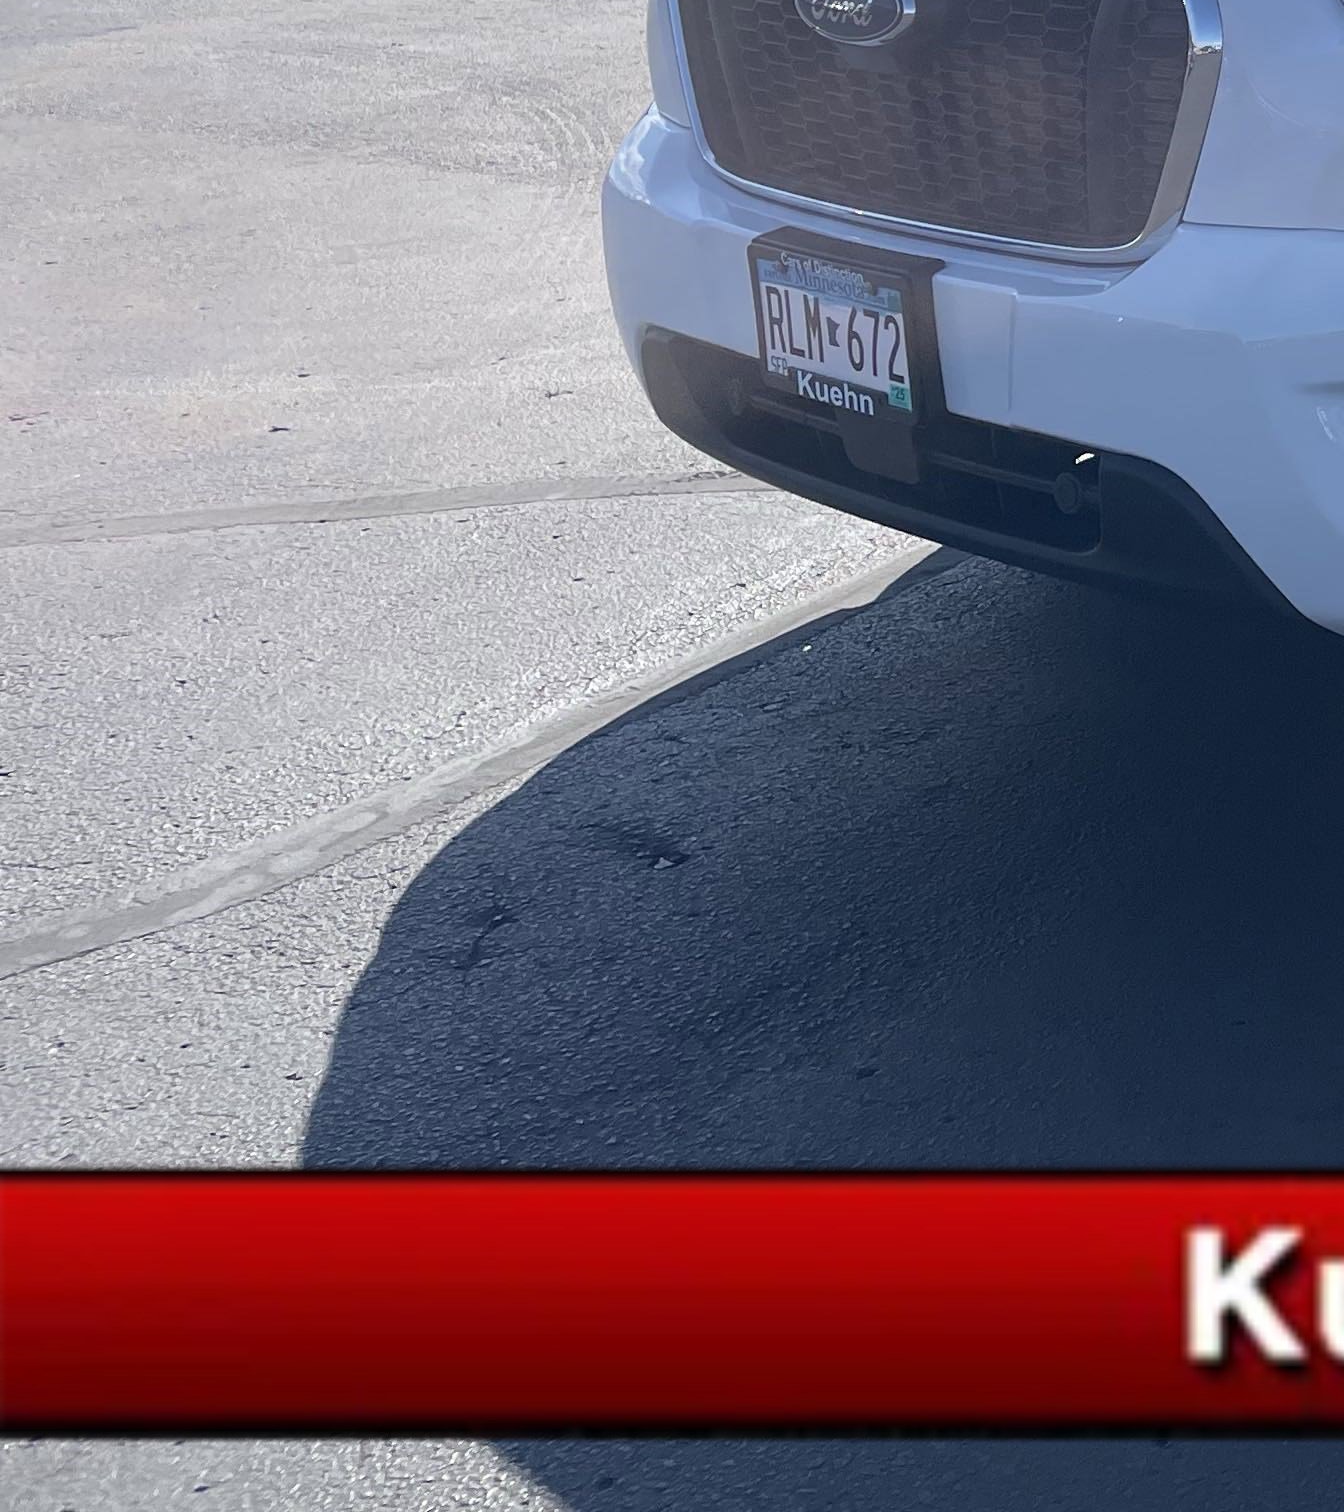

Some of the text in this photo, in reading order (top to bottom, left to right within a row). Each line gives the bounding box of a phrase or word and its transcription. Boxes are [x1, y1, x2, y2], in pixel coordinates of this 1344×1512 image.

[781, 252, 803, 269] Cars
[814, 260, 864, 284] Distinction
[796, 370, 875, 417] Kuehn
